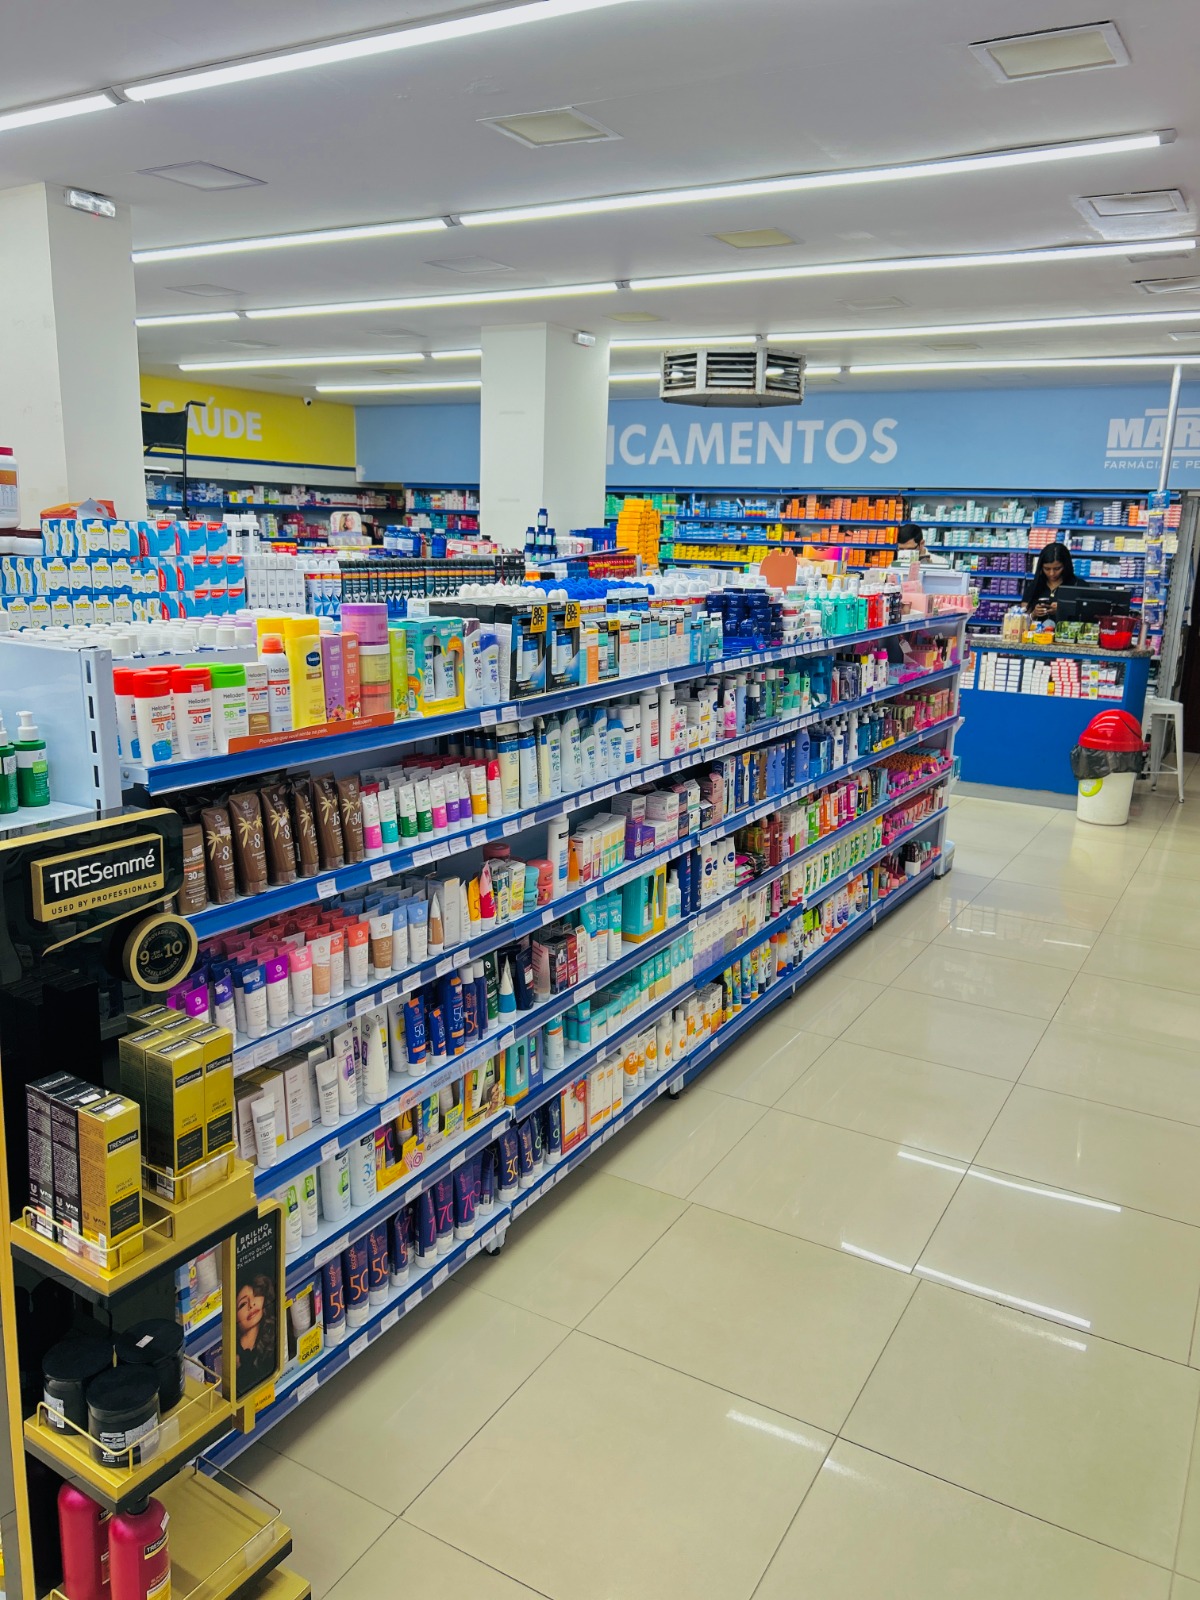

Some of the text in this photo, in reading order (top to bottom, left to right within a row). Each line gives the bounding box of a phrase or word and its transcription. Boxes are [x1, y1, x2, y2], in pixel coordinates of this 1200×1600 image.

[157, 396, 262, 442] AÚDE
[1103, 457, 1163, 469] FARMÁCI
[533, 615, 545, 626] OFF
[566, 612, 577, 622] OFF
[275, 687, 287, 696] 50
[156, 722, 165, 732] 70
[192, 716, 203, 725] 30
[284, 824, 291, 839] 8
[254, 833, 261, 848] 8
[222, 846, 230, 860] 8
[50, 849, 155, 894] TRESemmé
[187, 872, 198, 881] 30
[52, 904, 74, 915] USED
[91, 881, 158, 904] PROFESSIONALS
[140, 950, 150, 965] 9
[164, 940, 183, 958] 10
[414, 1023, 424, 1038] 50
[237, 1228, 272, 1254] LAMELAR
[240, 1223, 269, 1244] BRILHO
